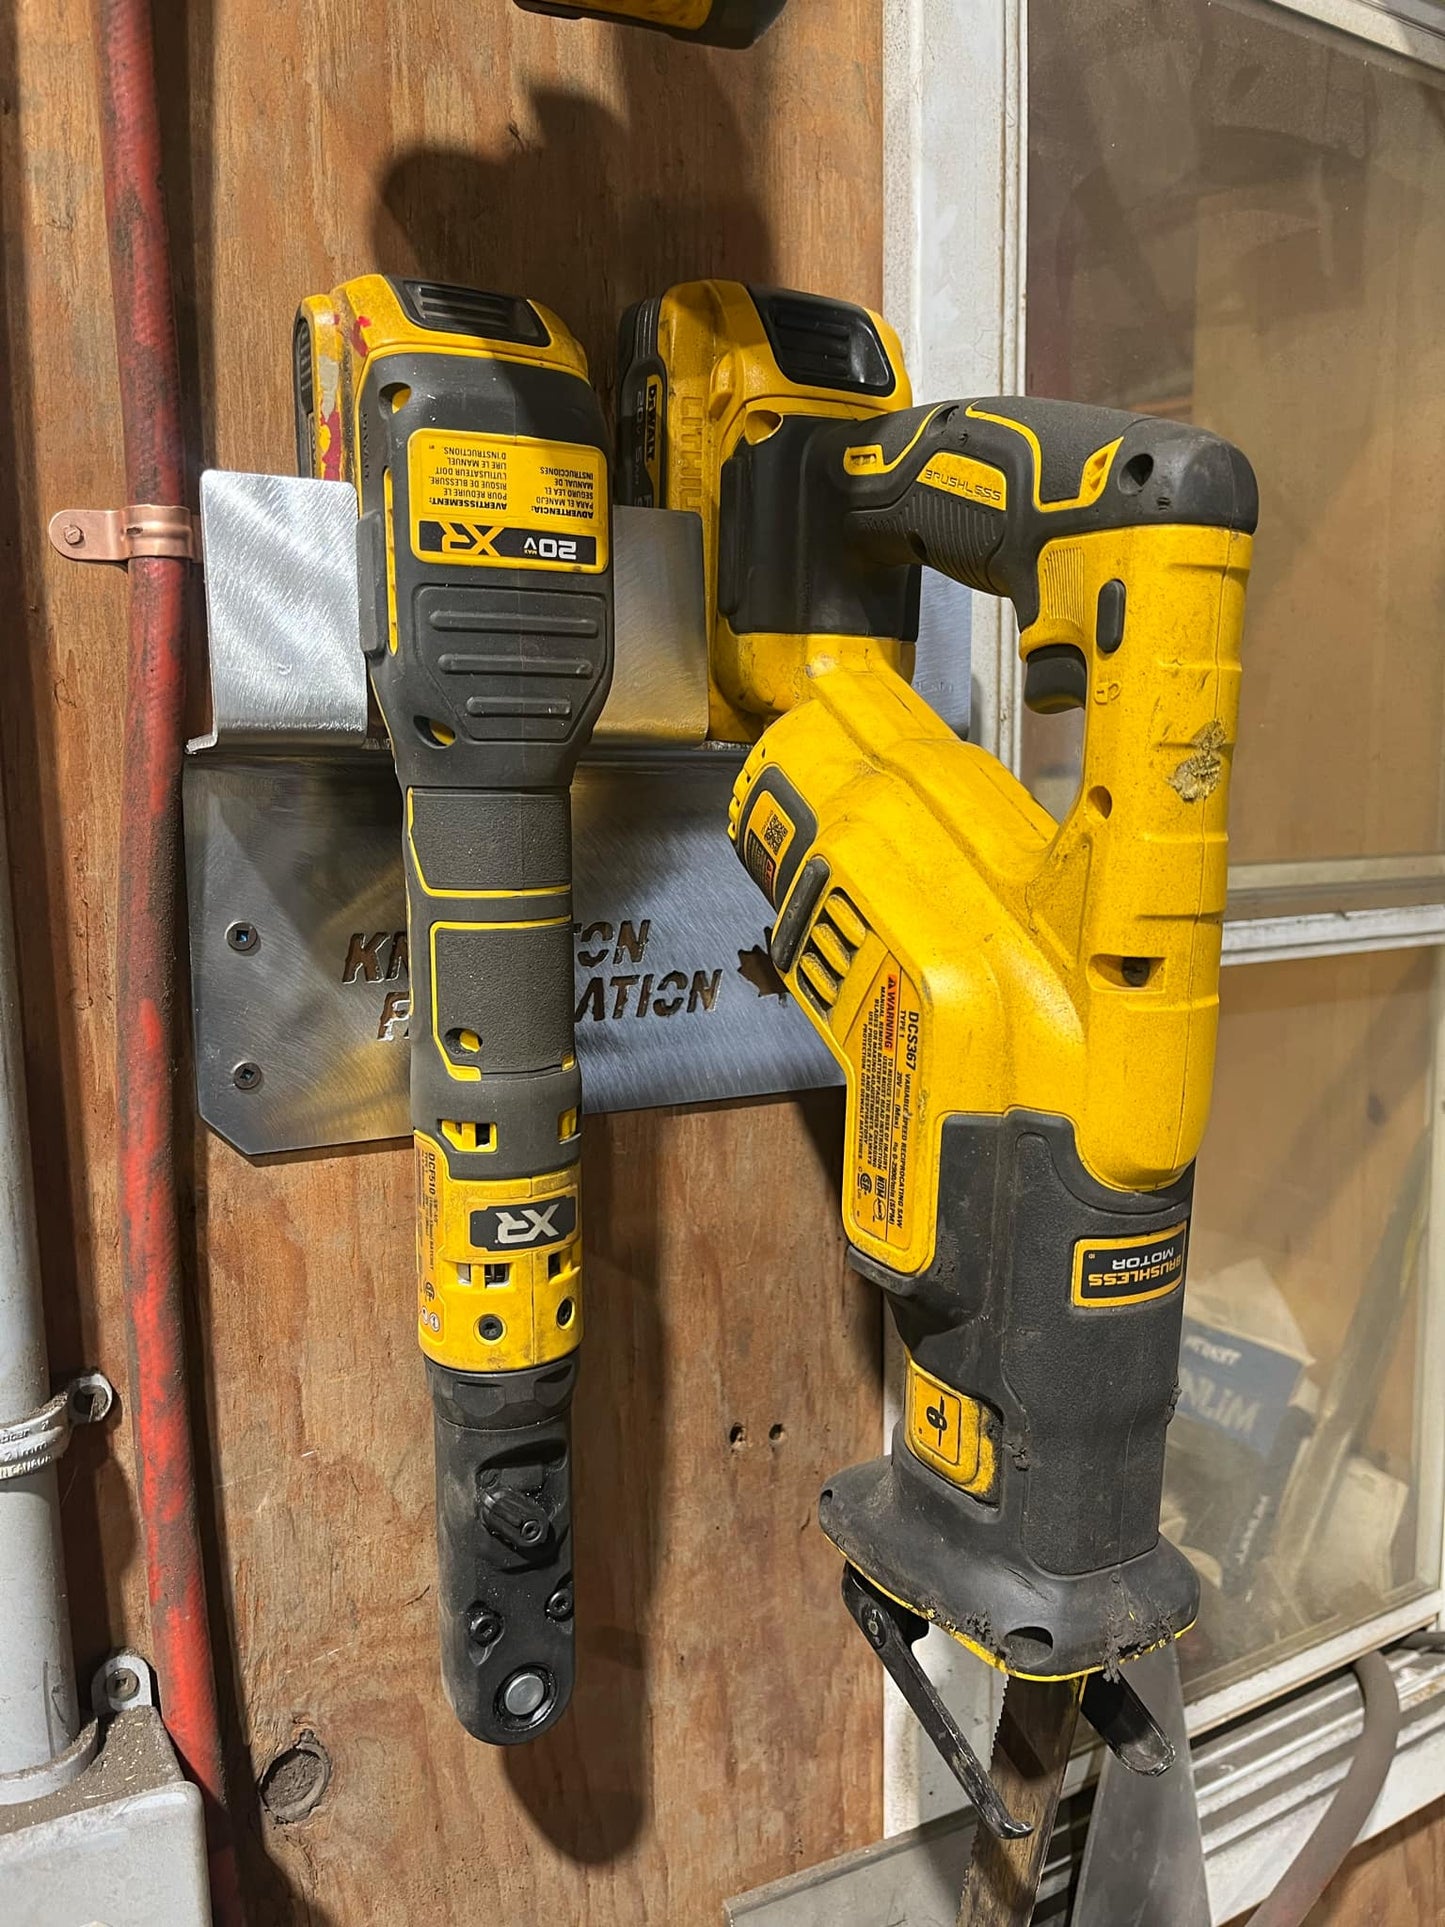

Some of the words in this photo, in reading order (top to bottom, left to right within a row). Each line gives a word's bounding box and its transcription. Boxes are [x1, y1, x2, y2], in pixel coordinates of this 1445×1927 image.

[448, 458, 479, 467] MANUEL
[482, 481, 507, 490] RISQUE
[565, 480, 594, 490] MANUAL
[924, 469, 1001, 501] BRUSHLESS
[488, 490, 507, 500] POUR
[568, 490, 594, 499] SEGURO
[429, 497, 507, 510] AVERTISSEMENT:
[536, 497, 565, 506] MANEJO
[576, 500, 594, 509] PARA
[531, 505, 594, 519] ADVERTENCIA:
[440, 522, 504, 556] XR
[884, 992, 896, 1048] WARNING
[873, 1030, 878, 1040] OR
[906, 1011, 919, 1071] DCS367
[888, 1058, 893, 1067] TO
[902, 1074, 911, 1113] VARIABLE
[884, 1133, 889, 1142] OF
[898, 1142, 907, 1207] RECIPROCATING
[495, 1204, 559, 1244] XR
[1112, 1246, 1174, 1270] MOTOR
[1088, 1255, 1182, 1287] BRUSHLESS
